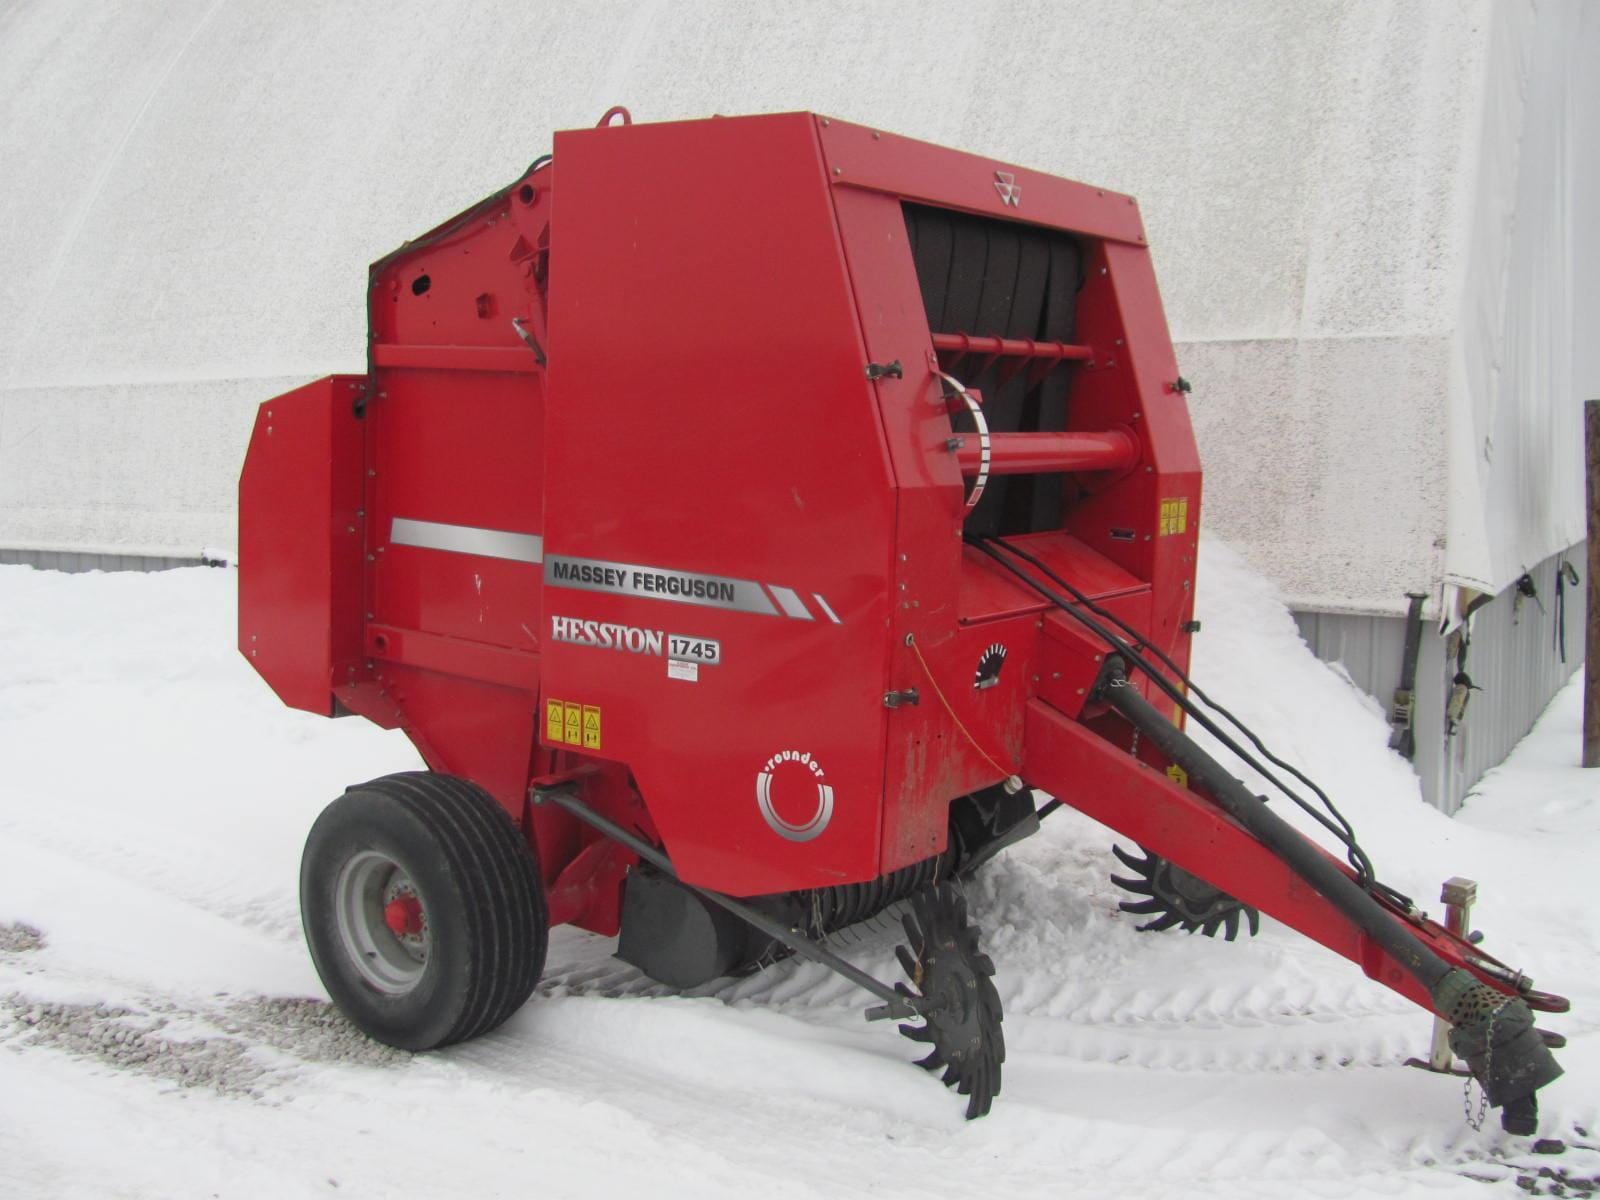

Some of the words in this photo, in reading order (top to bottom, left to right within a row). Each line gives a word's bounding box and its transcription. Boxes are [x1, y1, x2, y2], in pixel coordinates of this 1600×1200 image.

[553, 561, 627, 587] MASSEY
[632, 571, 736, 602] FERGUSON
[551, 615, 664, 657] HESSTON
[670, 639, 717, 660] 1745
